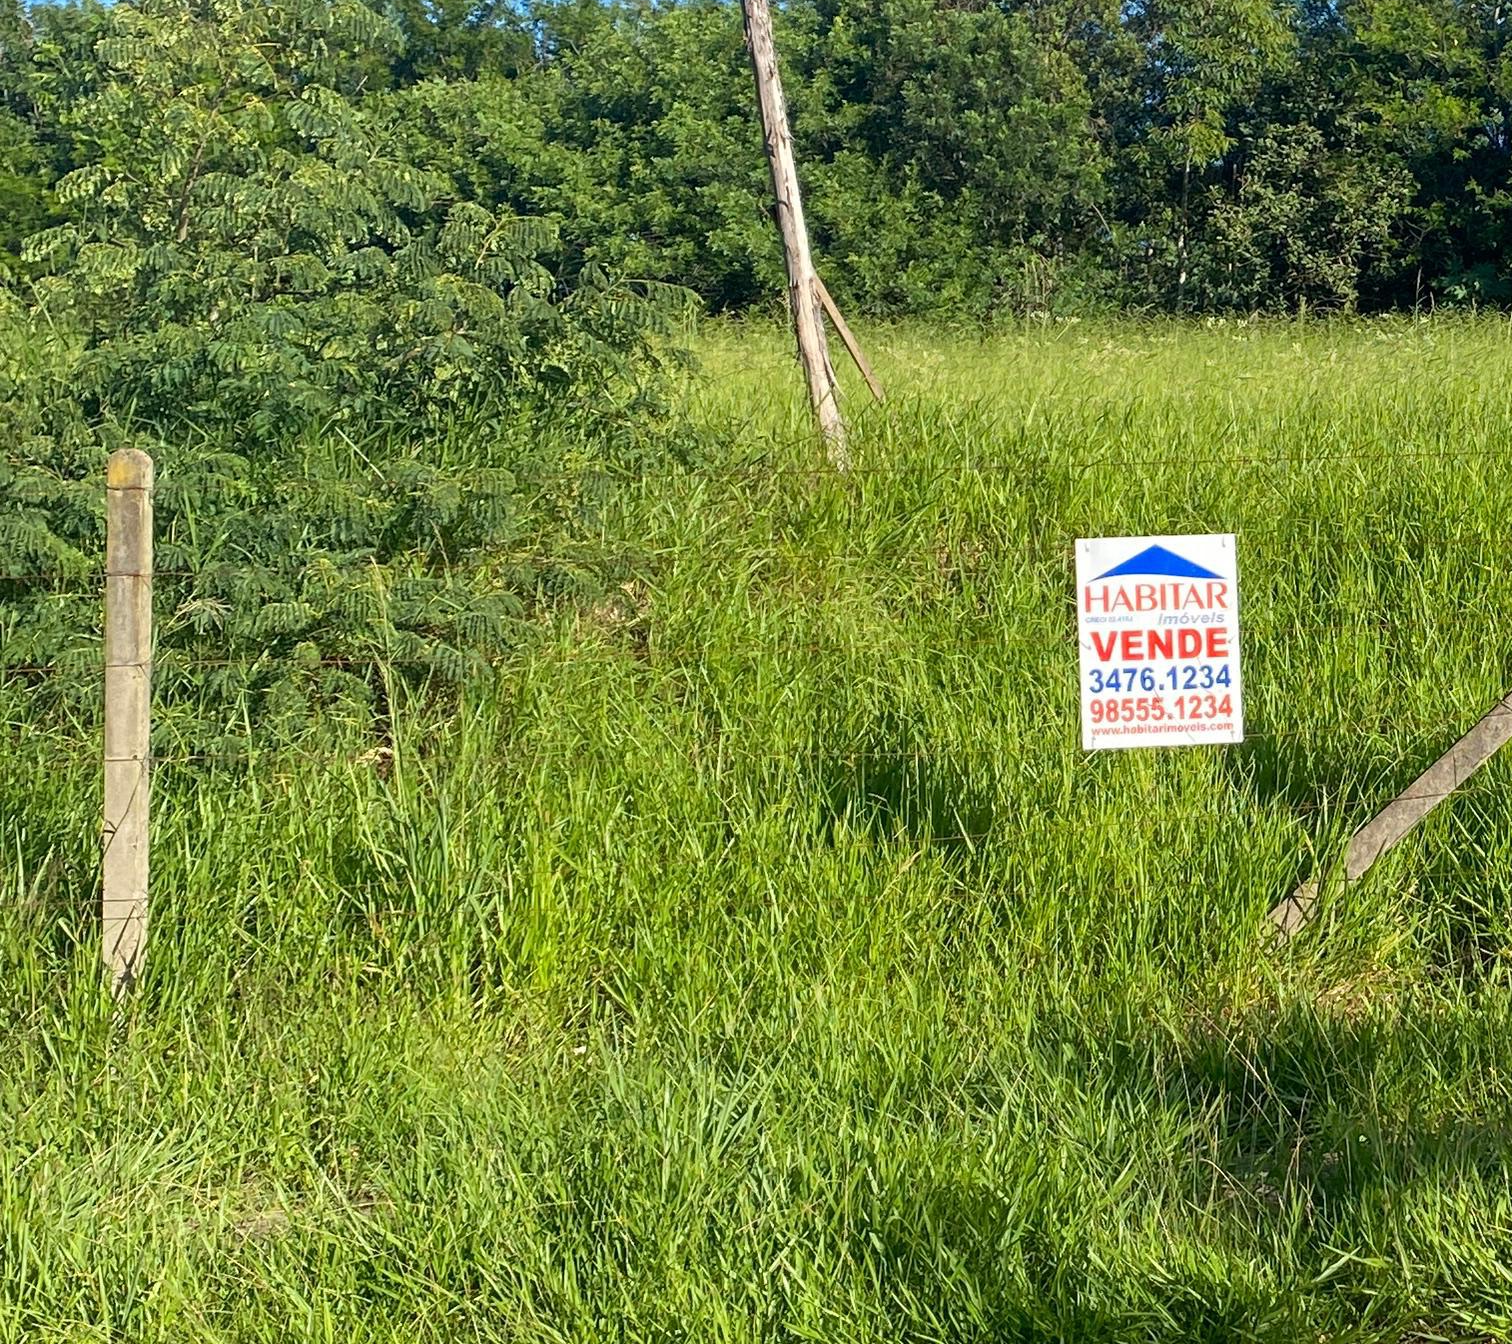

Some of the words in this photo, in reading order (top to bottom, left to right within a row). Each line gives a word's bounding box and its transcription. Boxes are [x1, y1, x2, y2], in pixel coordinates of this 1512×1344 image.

[1085, 582, 1228, 613] HABITAR
[1090, 627, 1229, 662] VENDE
[1089, 664, 1231, 694] 3476.1234
[1090, 694, 1233, 723] 98555.1234
